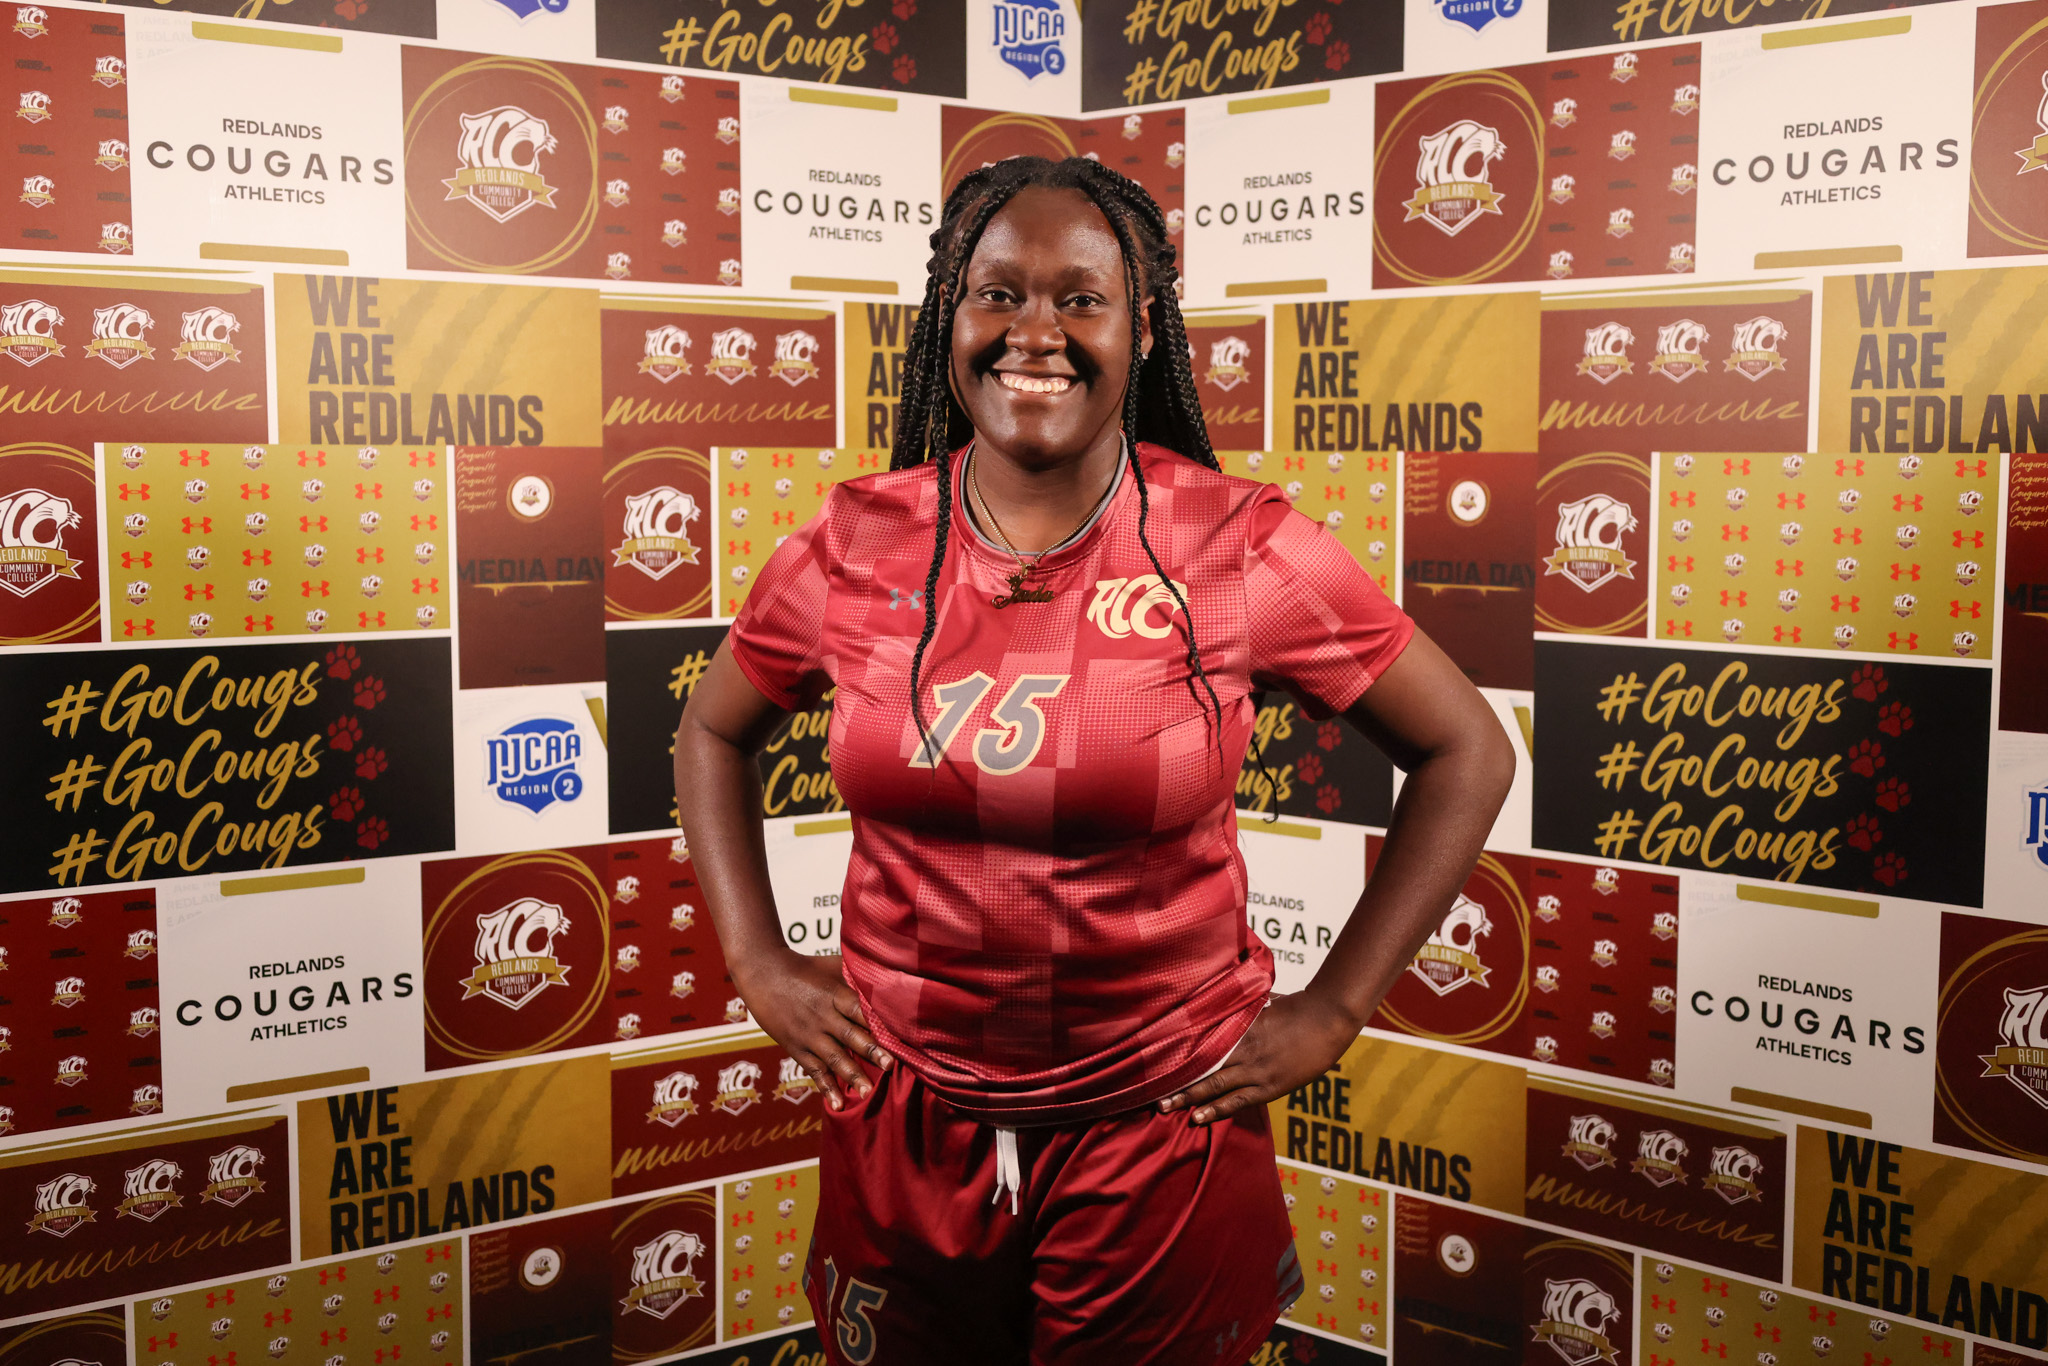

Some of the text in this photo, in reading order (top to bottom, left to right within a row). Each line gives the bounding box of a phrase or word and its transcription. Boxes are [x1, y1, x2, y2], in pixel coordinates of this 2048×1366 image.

[993, 4, 1065, 47] NJCAA
[1449, 2, 1491, 14] REGION
[659, 9, 868, 84] #GoCougs
[1050, 53, 1060, 70] 2
[1123, 30, 1302, 104] #GoCougs
[222, 118, 323, 140] REDLANDS
[1783, 117, 1883, 139] REDLANDS
[146, 140, 394, 185] COUGARS
[475, 169, 526, 186] REDLANDS
[809, 169, 882, 186] REDLANDS
[1244, 172, 1312, 190] REDLANDS
[1712, 139, 1959, 186] COUGARS
[223, 184, 325, 204] ATHLETICS
[753, 189, 933, 224] COUGARS
[1195, 191, 1364, 227] COUGARS
[1430, 184, 1475, 200] REDLANDS
[1781, 185, 1881, 206] ATHLETICS
[809, 226, 882, 242] ATHLETICS
[1242, 228, 1312, 246] ATHLETICS
[305, 274, 380, 328] WE
[1854, 271, 1934, 328] WE
[1295, 301, 1349, 347] WE
[308, 332, 395, 386] ARE
[1294, 351, 1358, 398] ARE
[1850, 331, 1947, 391] ARE
[309, 390, 543, 446] REDLANDS
[1294, 402, 1482, 451] REDLANDS
[7, 573, 38, 583] COLLEGE
[457, 558, 547, 584] MEDIA
[1404, 559, 1482, 584] MEDIA
[42, 654, 323, 738] #GoCougs
[1596, 661, 1847, 751] #GoCougs
[907, 670, 1072, 776] 15
[45, 729, 325, 812] #GoCougs
[487, 734, 581, 786] NJCAA
[1595, 731, 1845, 823] #GoCougs
[505, 778, 575, 796] REGION 2
[48, 801, 326, 887] #GoCougs
[1593, 801, 1842, 883] #GoCougs
[1247, 892, 1304, 911] EDLANDS
[249, 956, 345, 979] REDLANDS
[490, 958, 540, 977] REDLANDS
[495, 973, 536, 988] COMMUNITY
[1758, 975, 1853, 1002] REDLANDS
[176, 973, 414, 1027] COUGARS
[1691, 990, 1926, 1055] COUGARS
[250, 1016, 347, 1041] ATHLETICS
[1756, 1036, 1852, 1066] ATHLETICS
[327, 1086, 399, 1144] WE
[329, 1136, 413, 1199] ARE
[1287, 1115, 1471, 1202] REDLANDS
[1826, 1130, 1903, 1195] WE
[330, 1163, 555, 1255] REDLANDS
[1823, 1187, 1914, 1258] ARE
